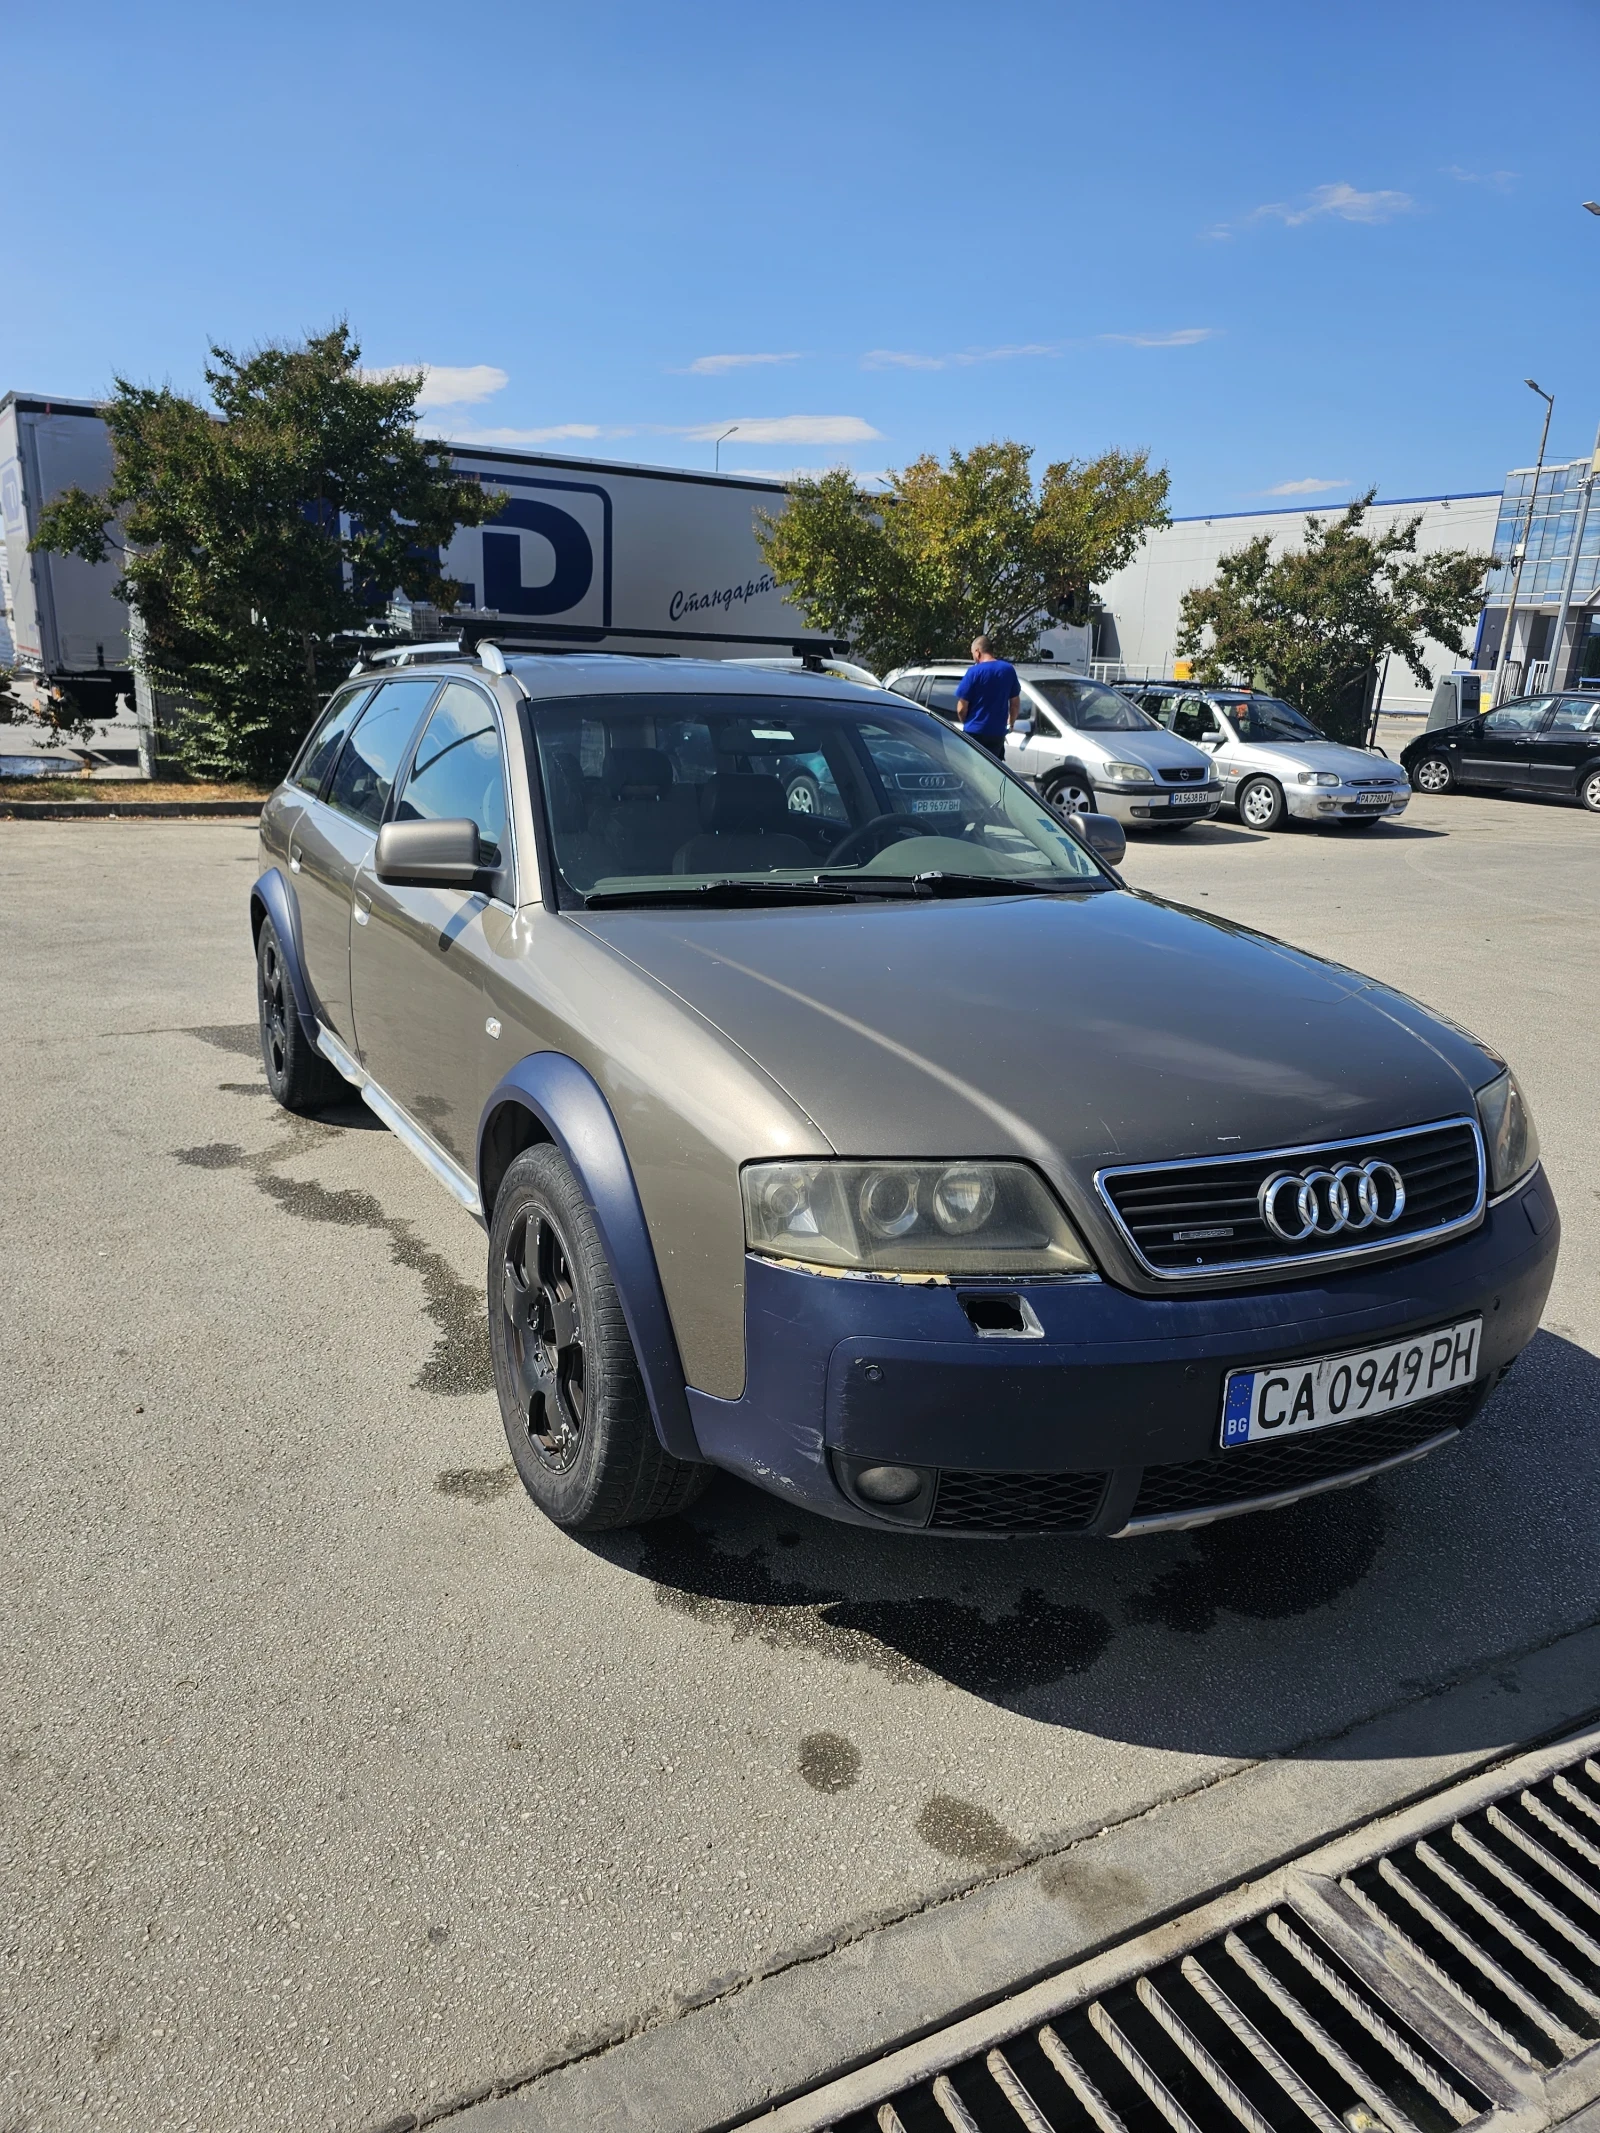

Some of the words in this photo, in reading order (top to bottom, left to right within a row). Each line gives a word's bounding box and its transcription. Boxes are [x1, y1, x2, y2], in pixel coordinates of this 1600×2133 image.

[1257, 1371, 1315, 1430] CA
[1328, 1346, 1423, 1415] 0949
[1426, 1327, 1476, 1389] PH
[1226, 1416, 1249, 1436] BG
